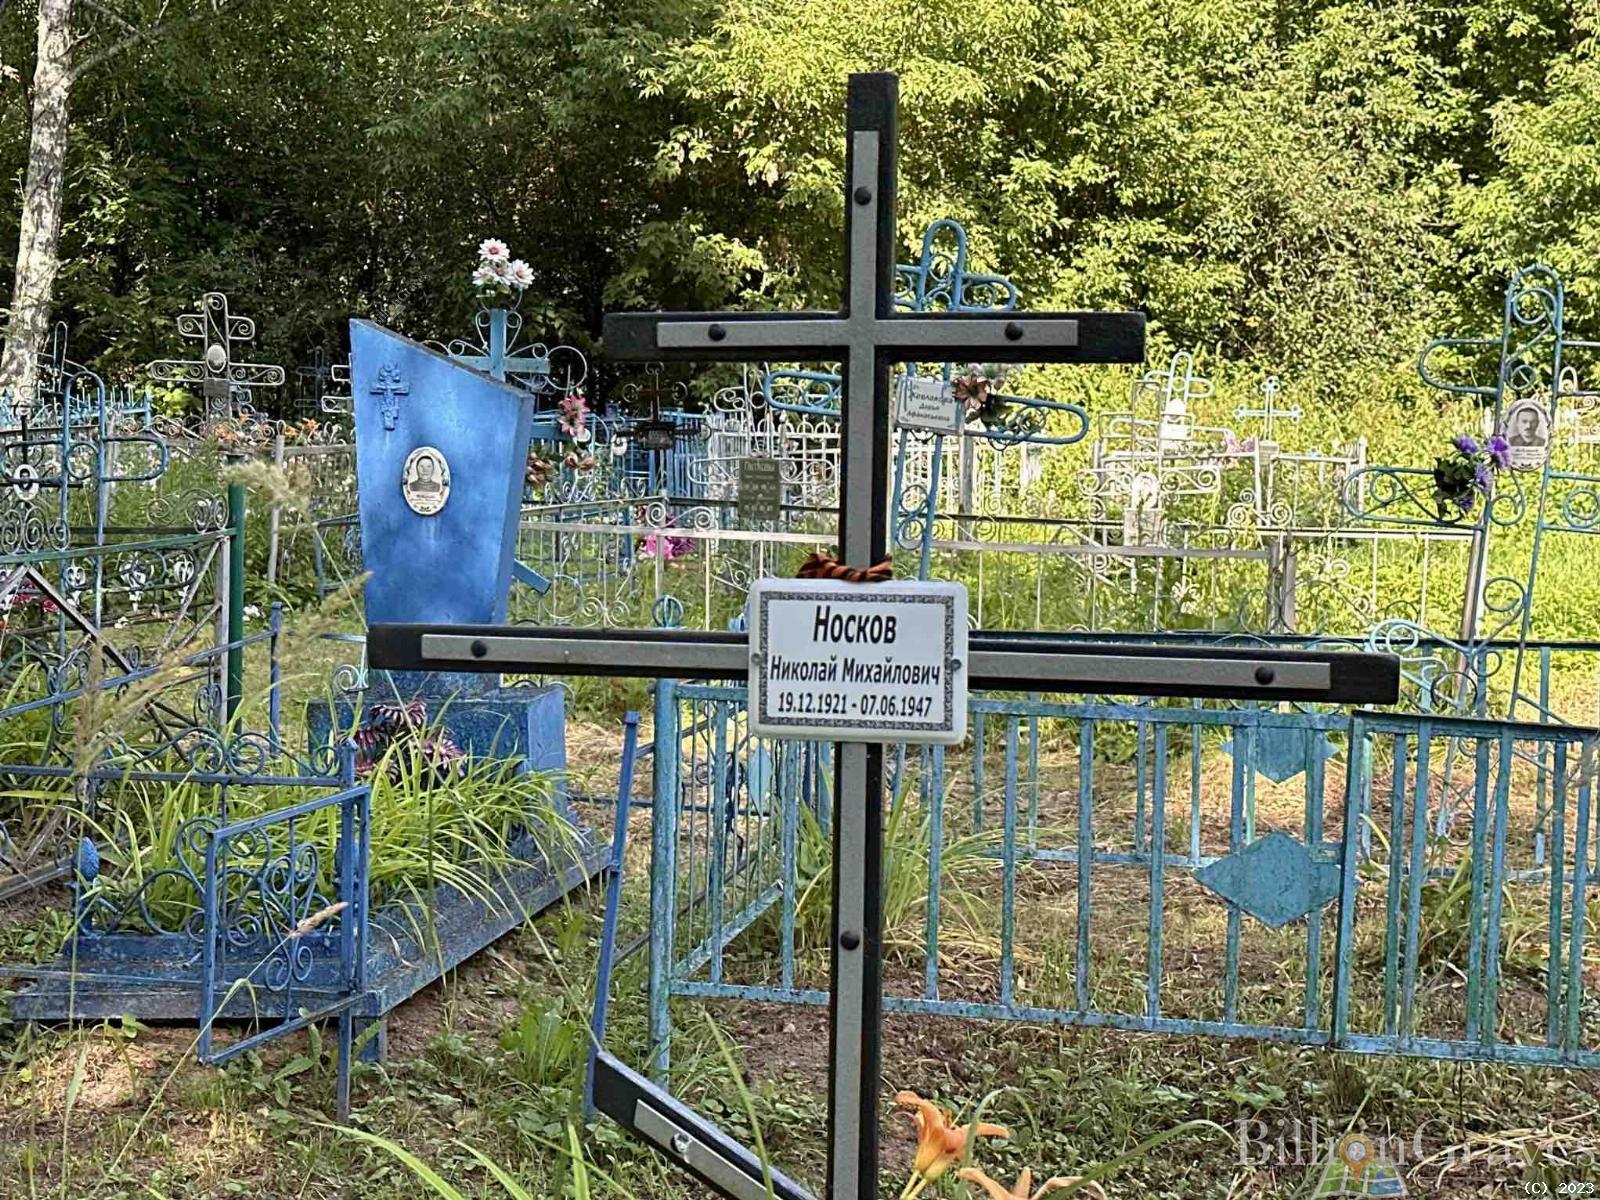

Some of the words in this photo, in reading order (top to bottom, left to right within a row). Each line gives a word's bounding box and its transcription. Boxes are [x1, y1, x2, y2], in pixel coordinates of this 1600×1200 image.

[813, 605, 897, 644] Носков
[770, 655, 837, 683] Николай
[842, 657, 940, 685] Михайлович
[778, 692, 847, 714] 19.12.1921
[860, 695, 932, 718] 07.06.1947
